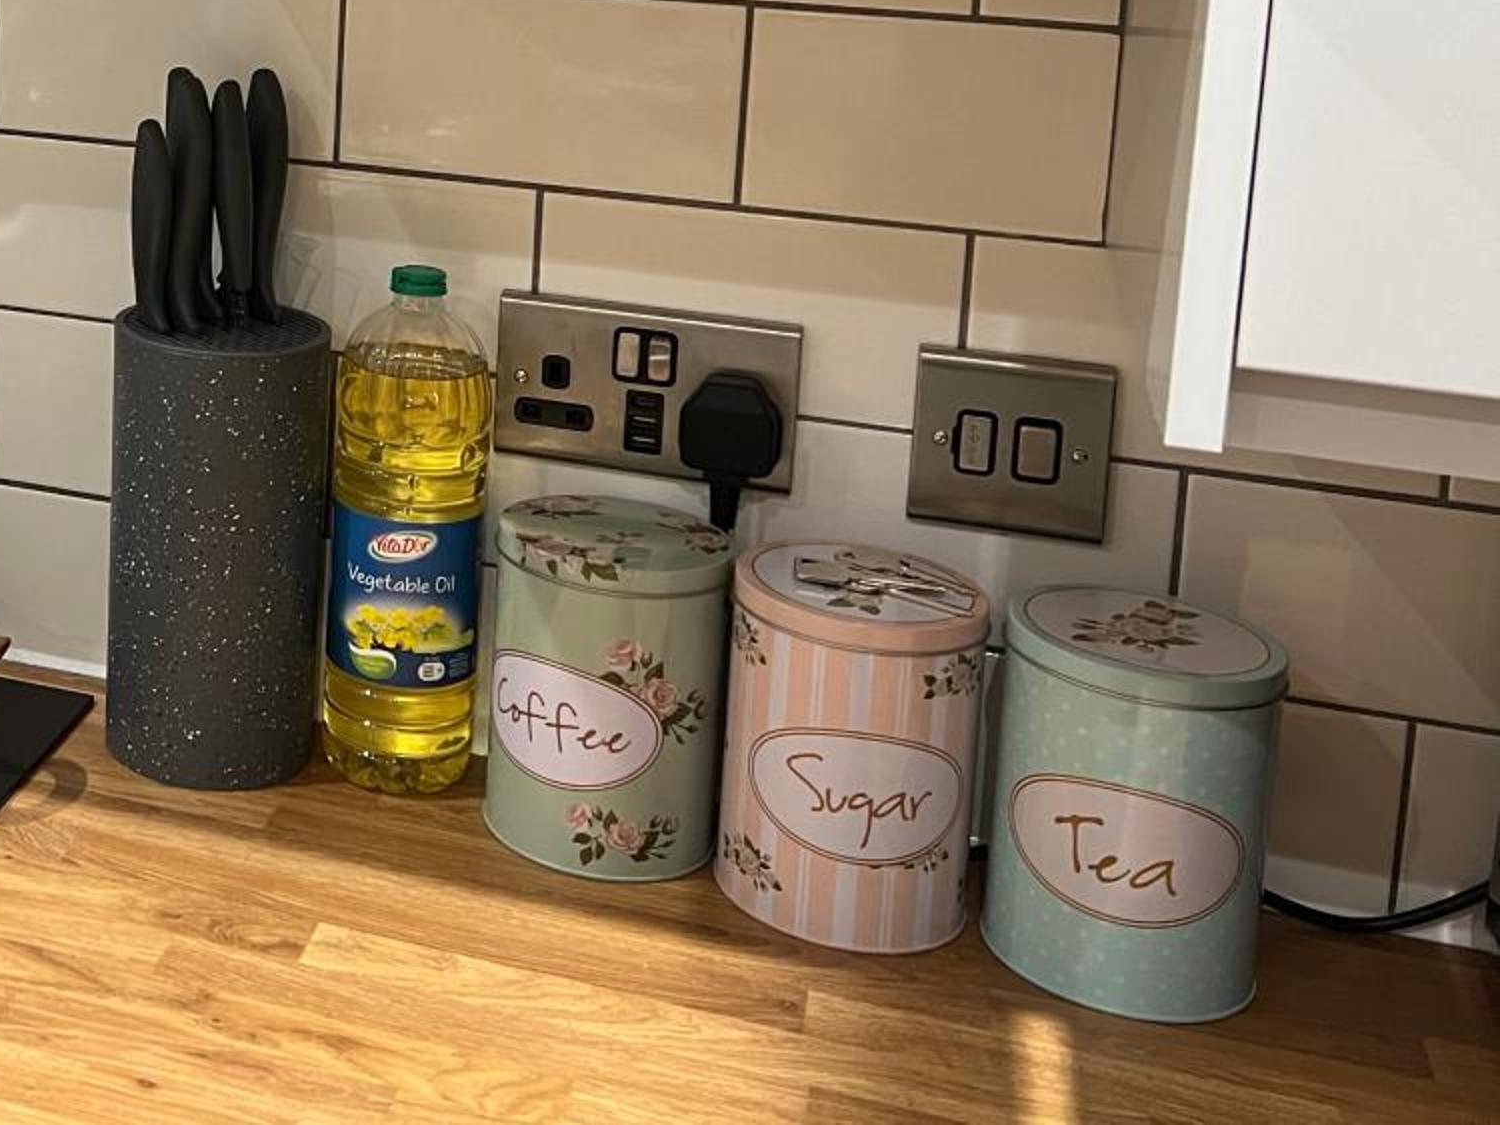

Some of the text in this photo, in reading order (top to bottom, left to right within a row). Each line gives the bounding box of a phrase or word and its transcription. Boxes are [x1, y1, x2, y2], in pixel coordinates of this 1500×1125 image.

[347, 560, 456, 594] Vegetable Oil
[497, 677, 632, 754] Coffee
[786, 752, 933, 850] Sugar
[1054, 814, 1177, 897] Tea
